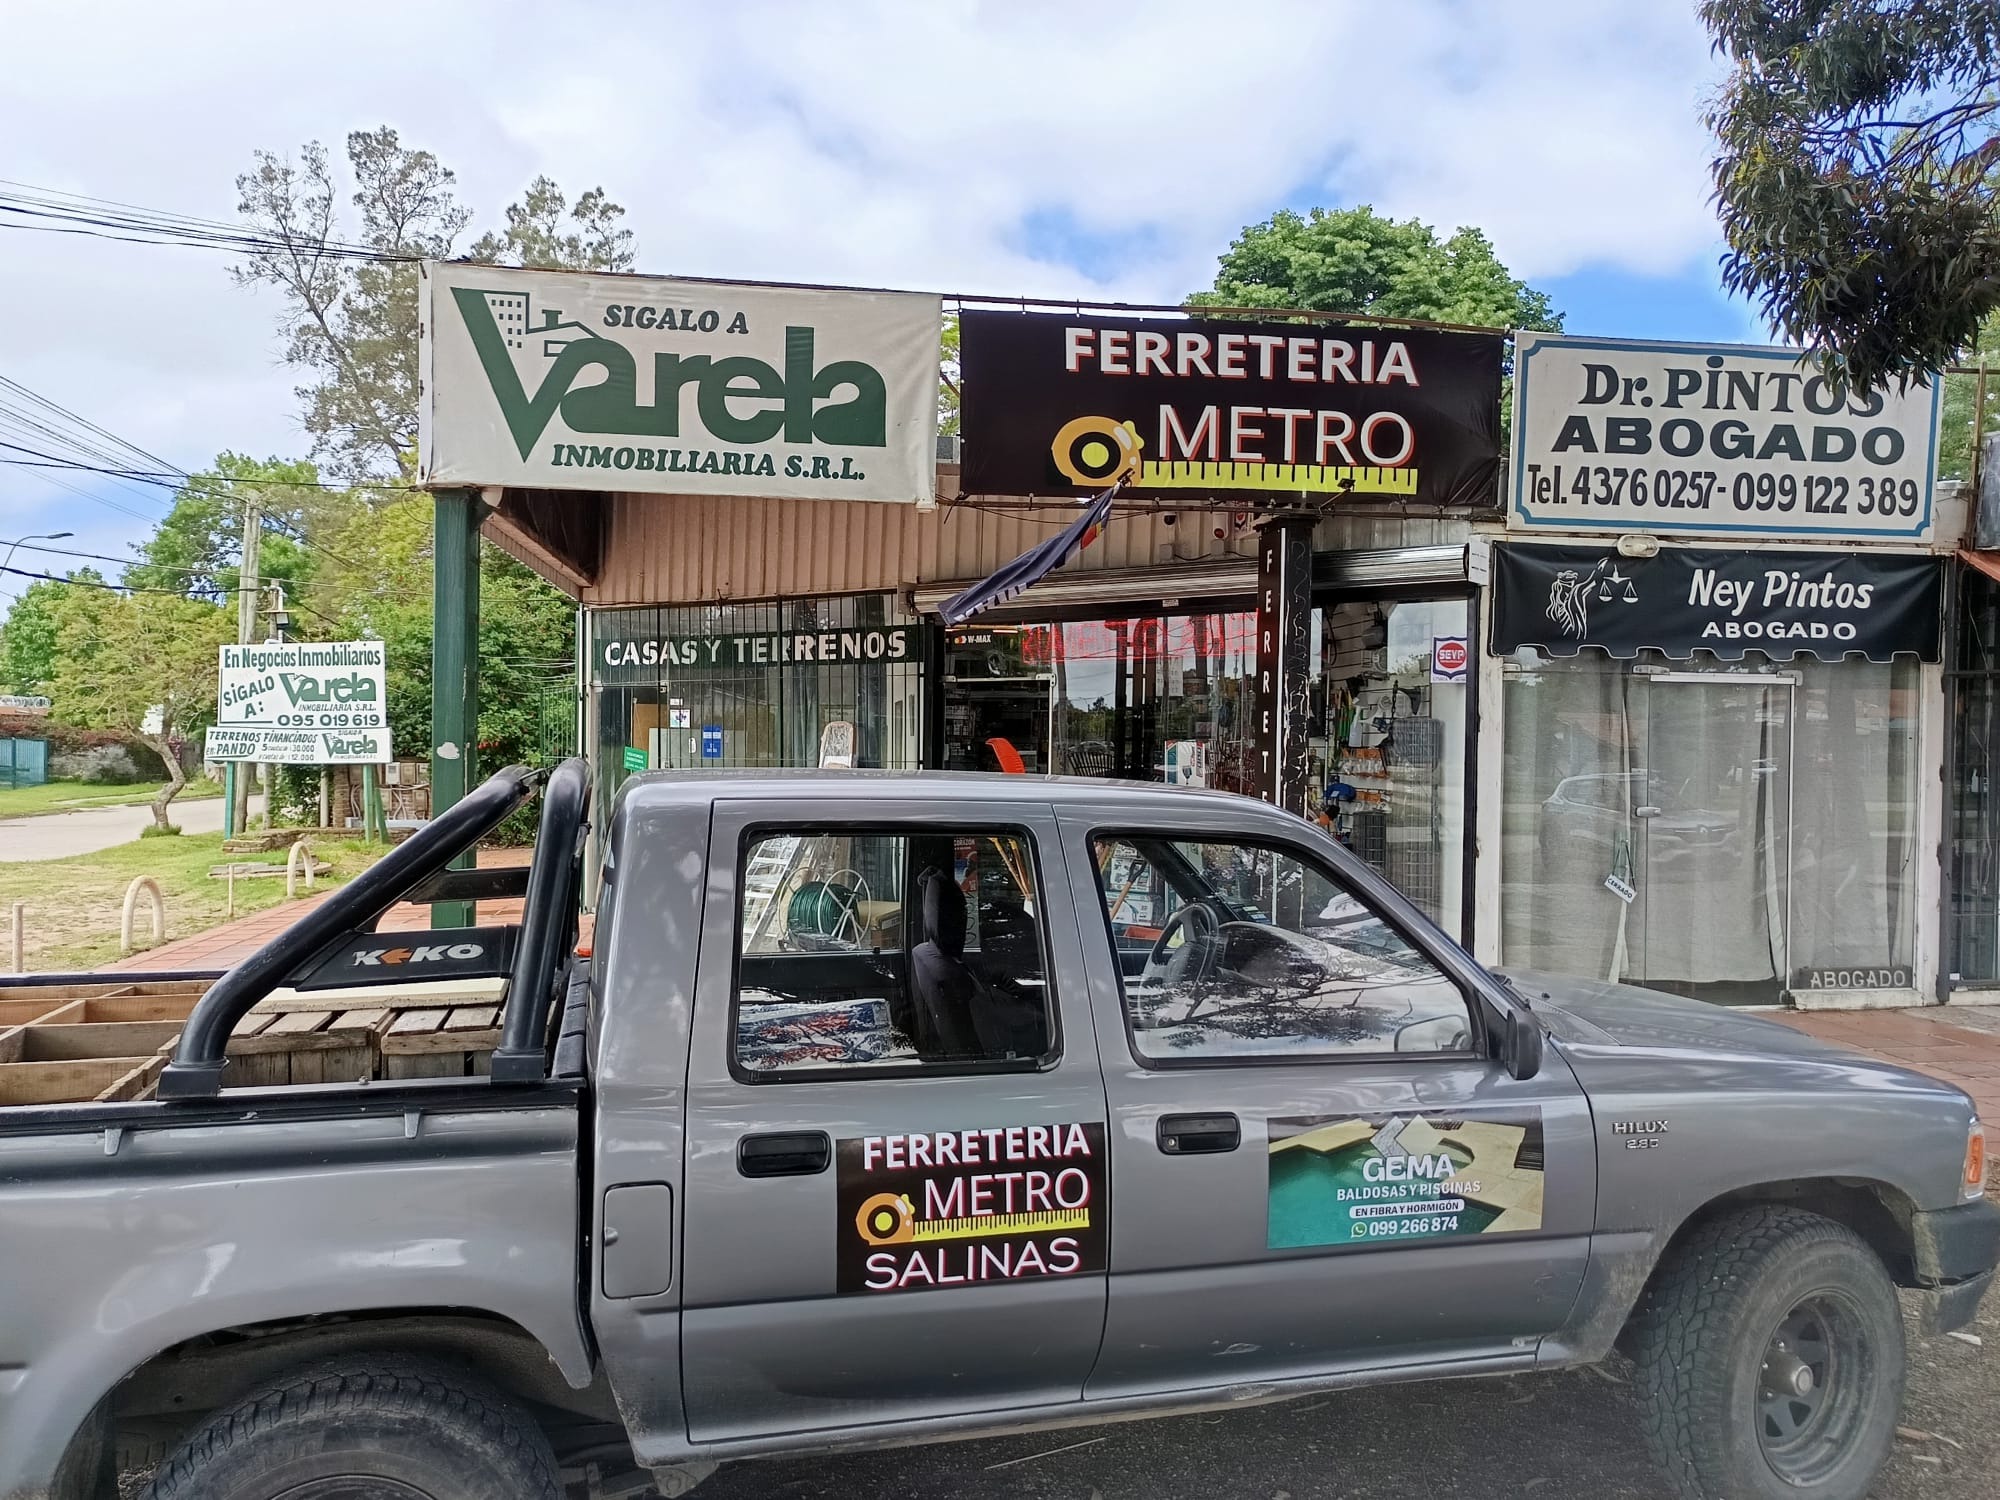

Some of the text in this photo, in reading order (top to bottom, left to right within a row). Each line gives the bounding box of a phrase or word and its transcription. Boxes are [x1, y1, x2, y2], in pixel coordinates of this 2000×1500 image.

[603, 304, 750, 335] SIGALO A
[1064, 326, 1420, 387] FERRETERIA
[451, 286, 887, 464] Varela
[1158, 403, 1417, 467] METRO
[1550, 415, 1906, 466] ABOGADO
[550, 443, 866, 481] INMOBILIARIA S.R.L.
[1527, 463, 1568, 505] Tel.
[1732, 471, 1797, 512] 099
[1803, 475, 1850, 515] 122
[1857, 476, 1919, 517] 389
[1687, 568, 1875, 617] Ney Pintos
[1701, 621, 1857, 640] ABOGADO
[224, 642, 382, 672] En Negocios Inmobiliarios
[604, 630, 907, 666] CASAS Y TERRENOS
[278, 671, 377, 709] Varela
[277, 713, 381, 727] 095 019 619
[298, 703, 353, 712] INMOBILIARIA
[209, 730, 260, 743] TERRENOS
[216, 742, 256, 756] PANDO
[322, 732, 378, 759] Varela
[1810, 969, 1906, 989] ABOGADO
[1612, 1120, 1669, 1134] HILUX
[863, 1122, 1092, 1171] FERRETERIA
[1362, 1153, 1456, 1183] GEMA
[925, 1167, 1091, 1220] METRO
[1336, 1180, 1482, 1201] BALDOSAS Y PISCINAS
[1355, 1200, 1460, 1217] EN FIBRA Y HORMIGÓN
[1369, 1216, 1459, 1236] 099 266 874
[864, 1236, 1081, 1290] SALINAS
